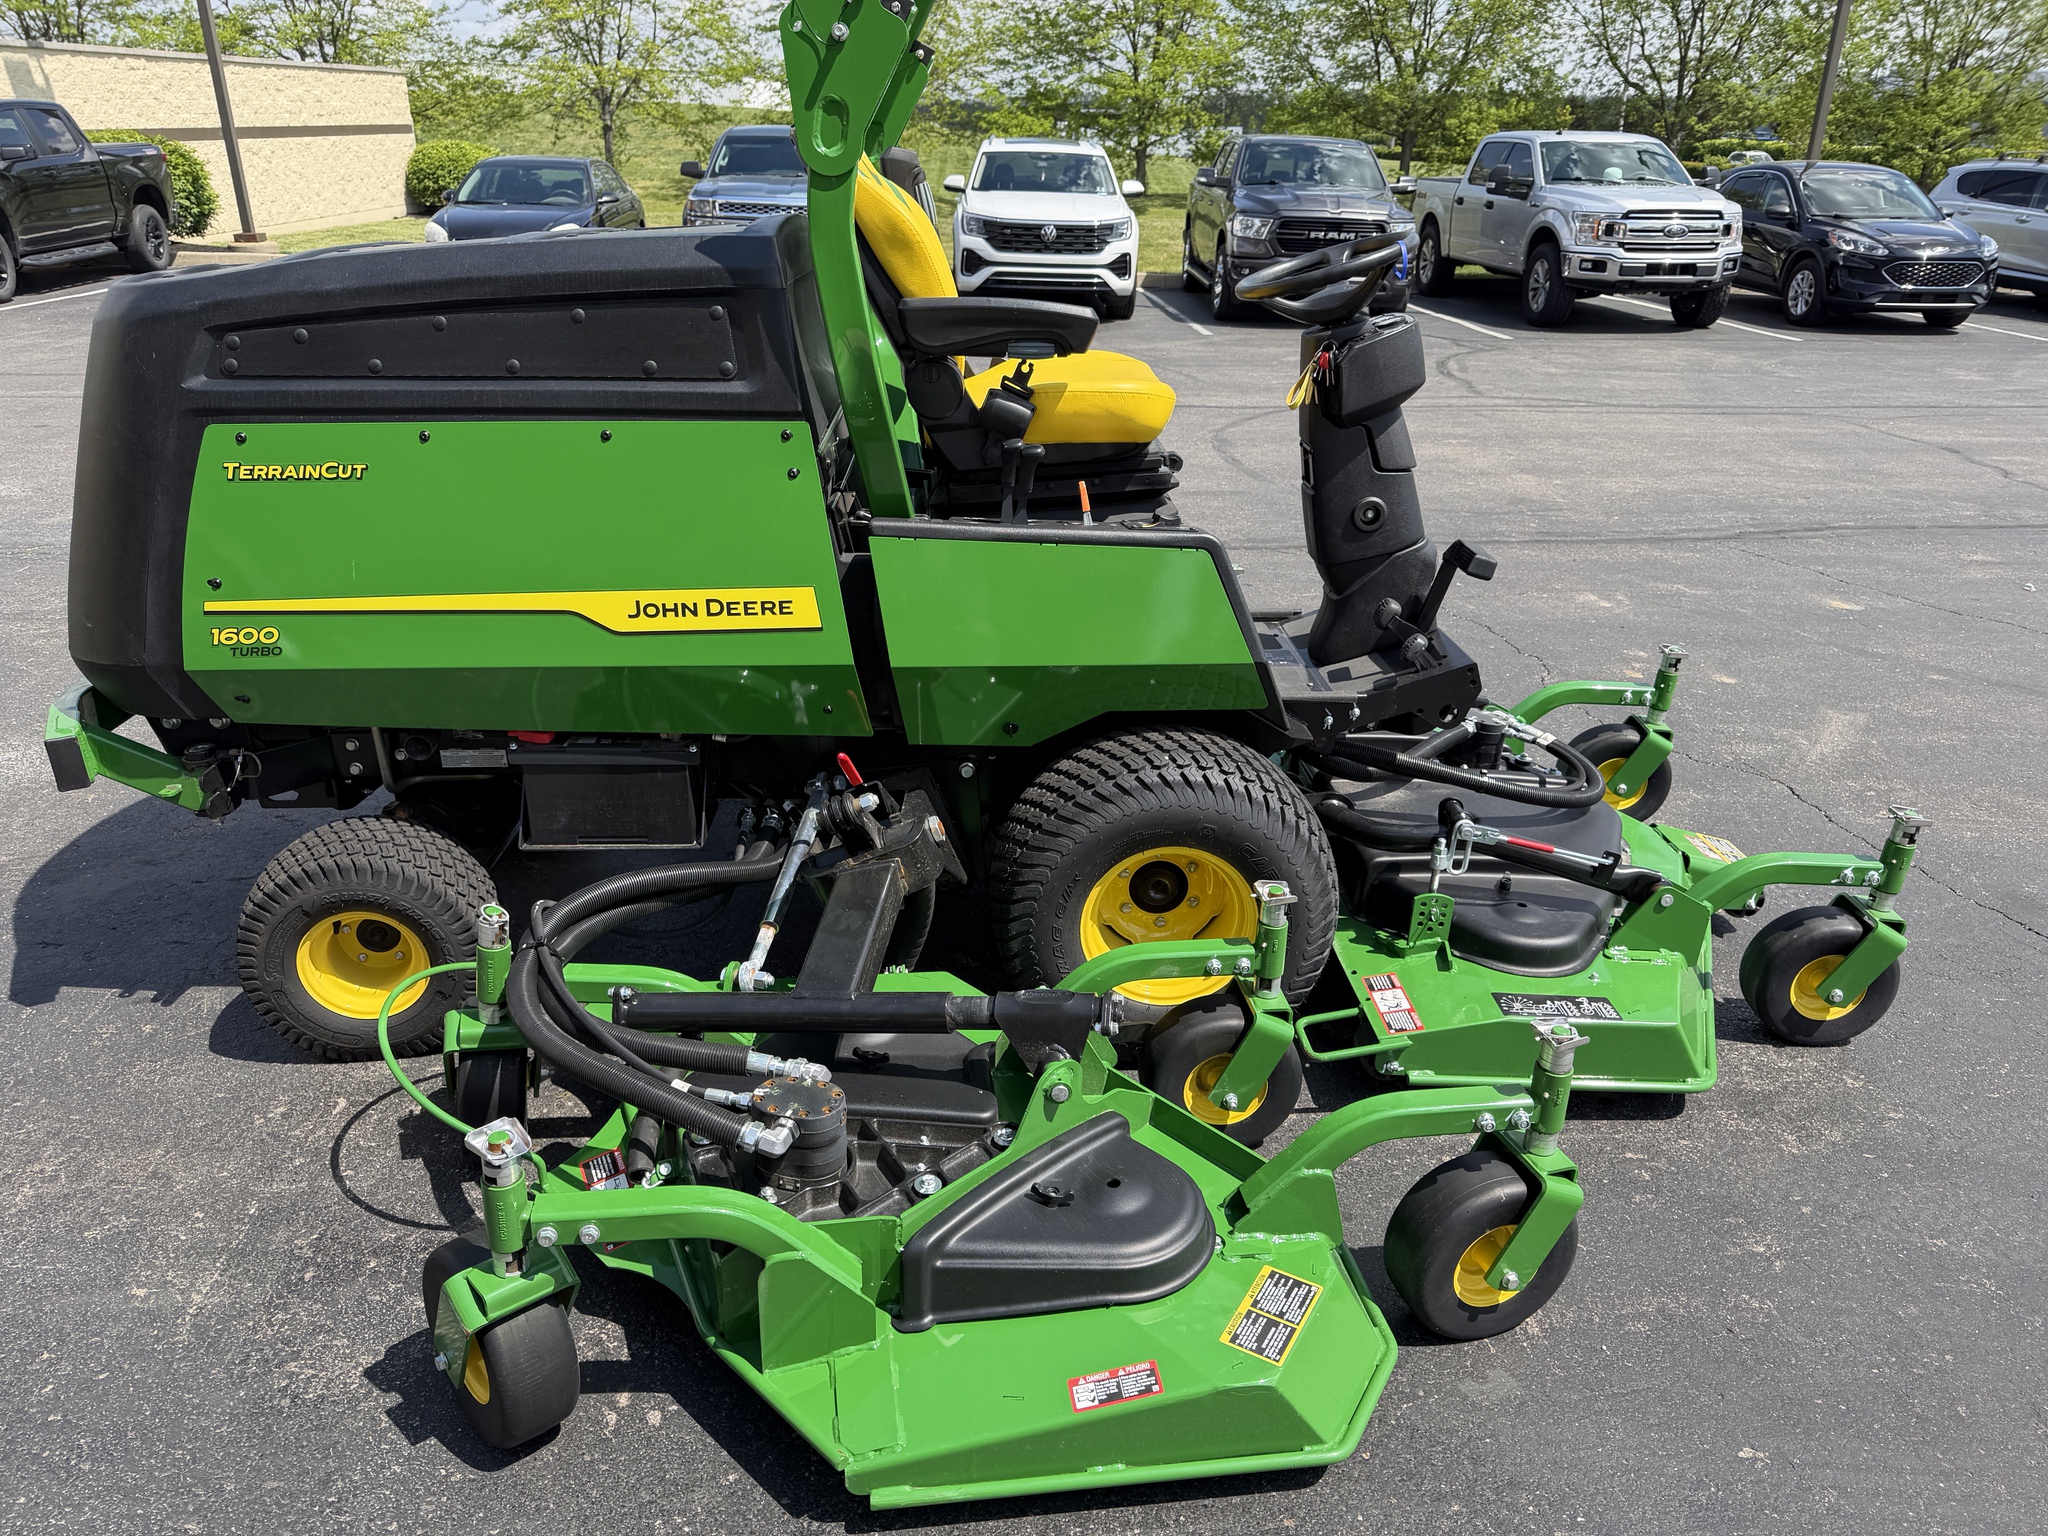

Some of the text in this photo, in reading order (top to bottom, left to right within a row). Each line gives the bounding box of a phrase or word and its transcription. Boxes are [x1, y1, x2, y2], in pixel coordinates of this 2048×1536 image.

[1309, 231, 1356, 240] RAM
[211, 626, 280, 646] 1600
[230, 646, 283, 657] TURBO
[320, 891, 390, 906] MULTI
[1125, 1363, 1150, 1373] PELIGRO
[1086, 1371, 1110, 1382] DANGER
